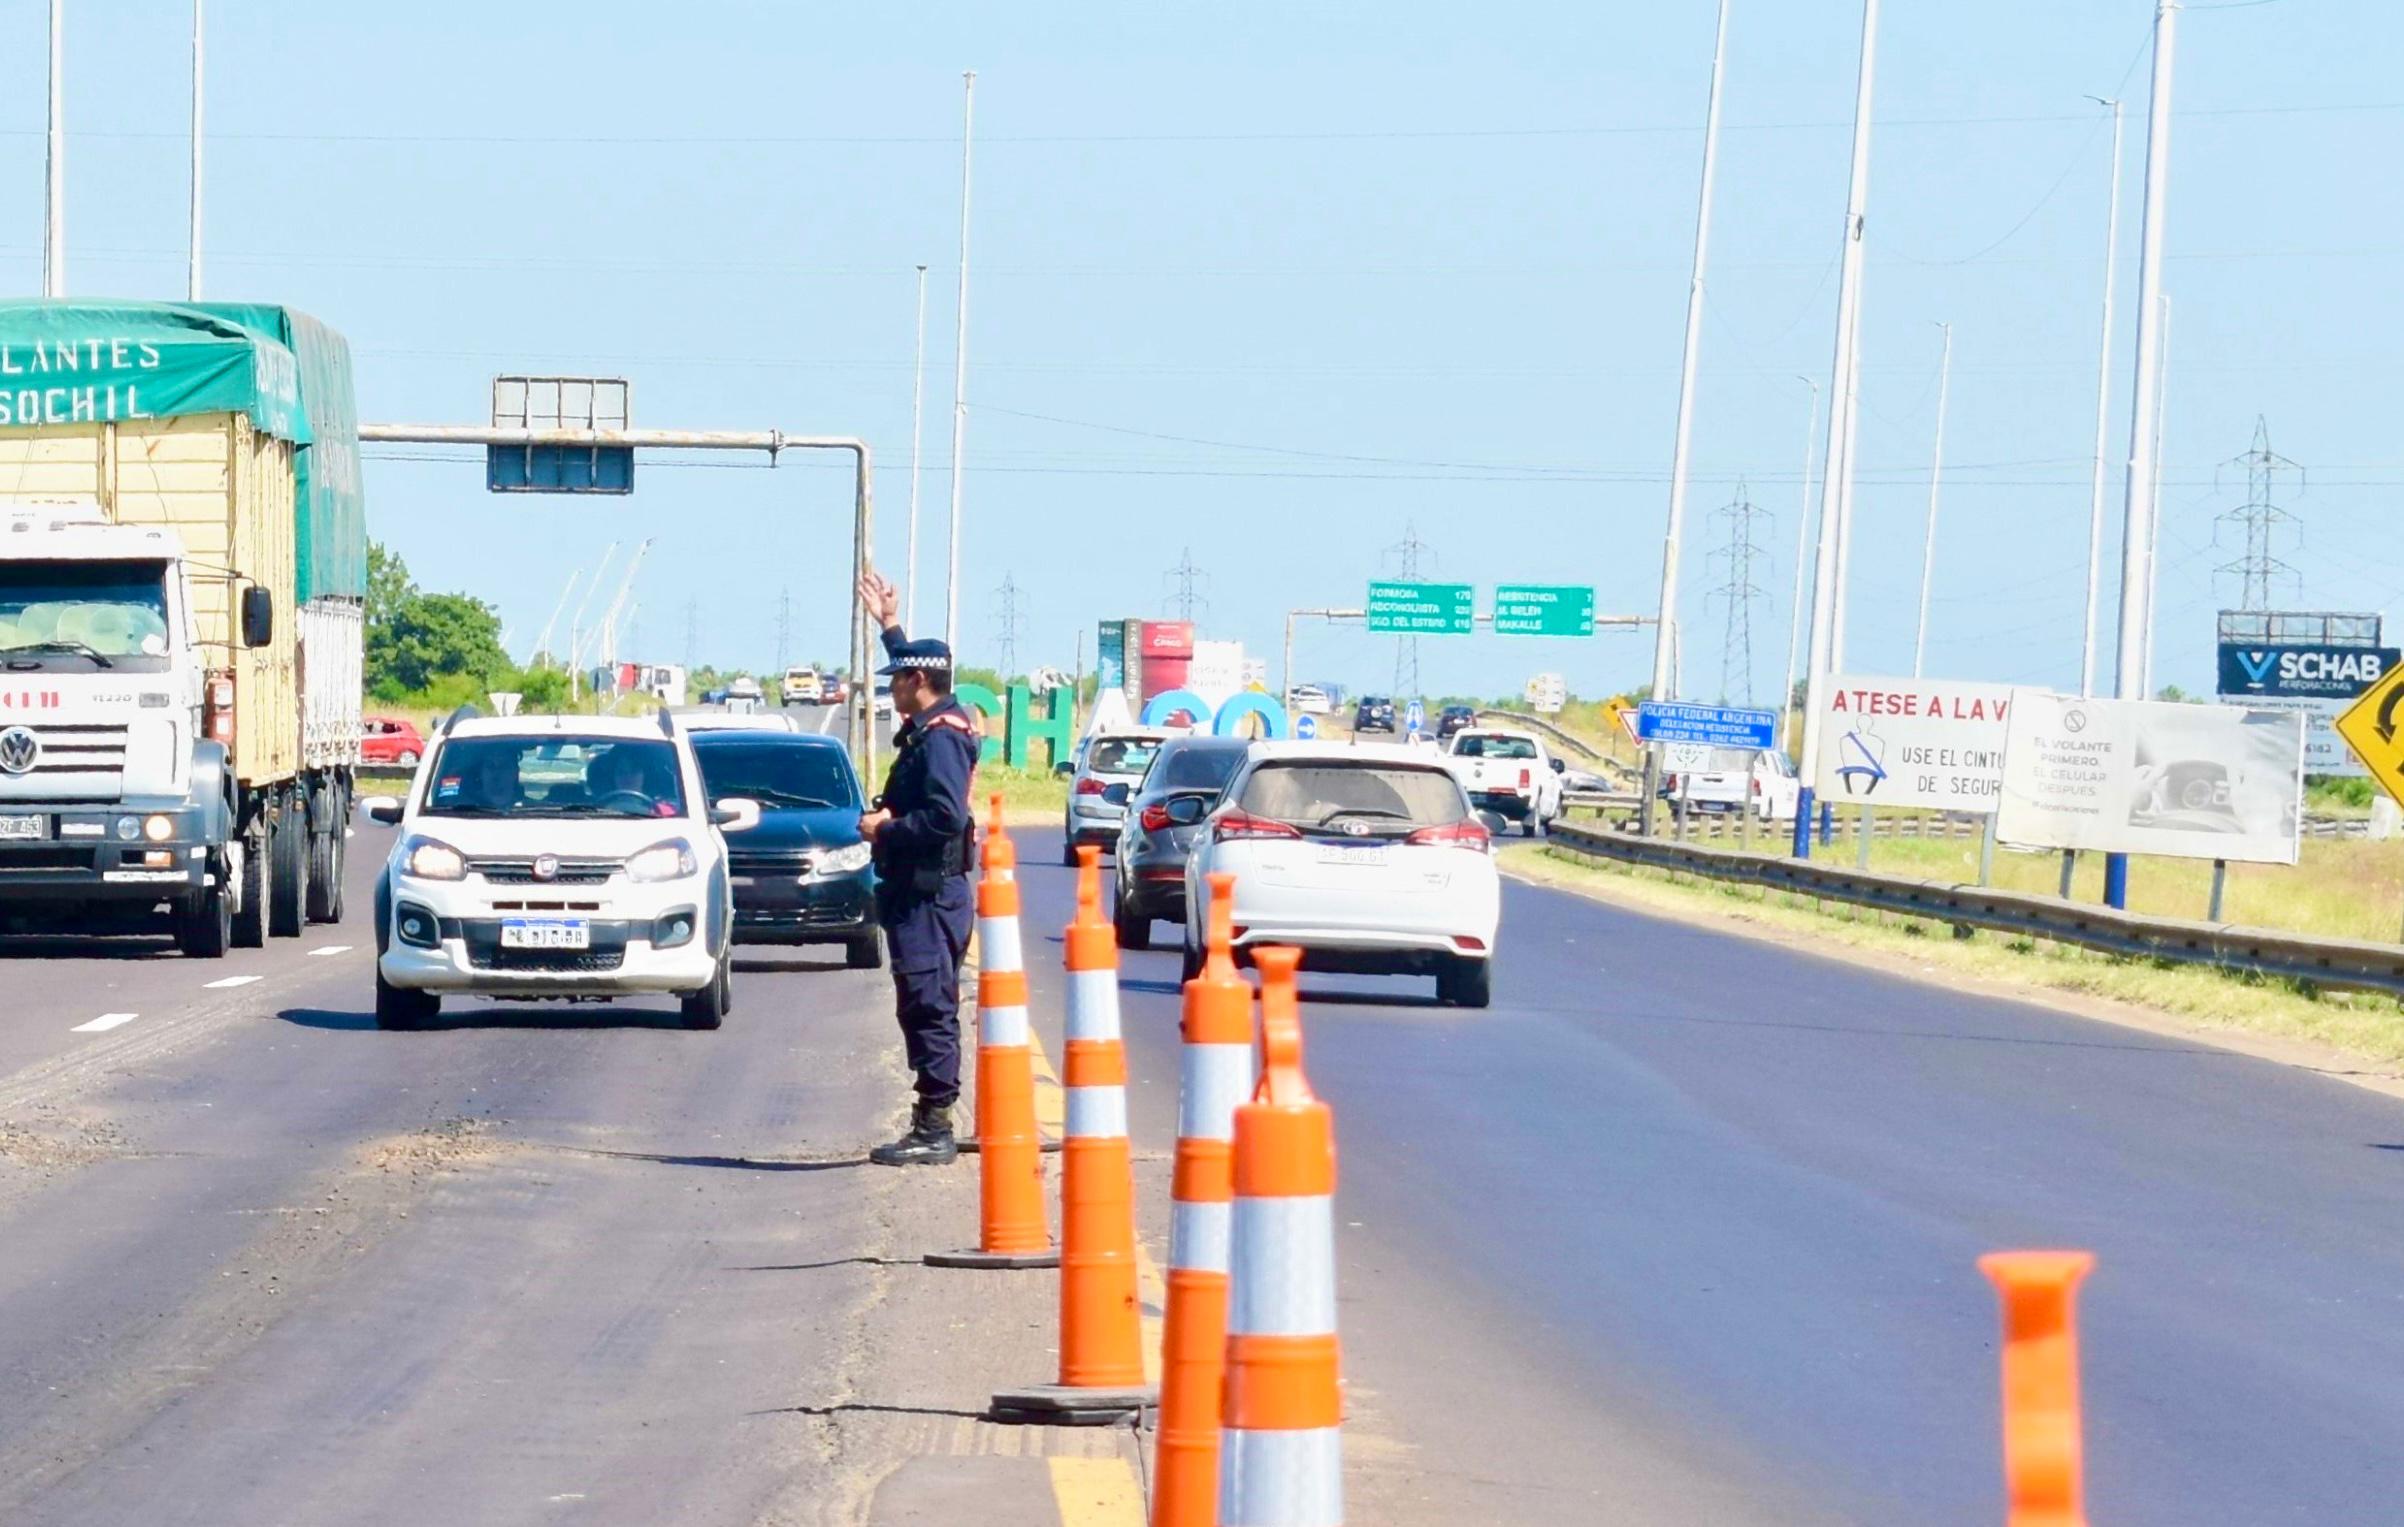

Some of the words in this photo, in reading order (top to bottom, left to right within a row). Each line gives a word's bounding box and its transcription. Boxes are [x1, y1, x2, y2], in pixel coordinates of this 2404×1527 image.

[1, 337, 161, 375] LANTES
[2279, 652, 2382, 682] SCHAB
[1953, 697, 1984, 721] LA
[1902, 747, 1934, 765] USE
[1940, 749, 1958, 767] EL
[2051, 740, 2112, 753] VOLANTE
[1917, 776, 1938, 794] DE
